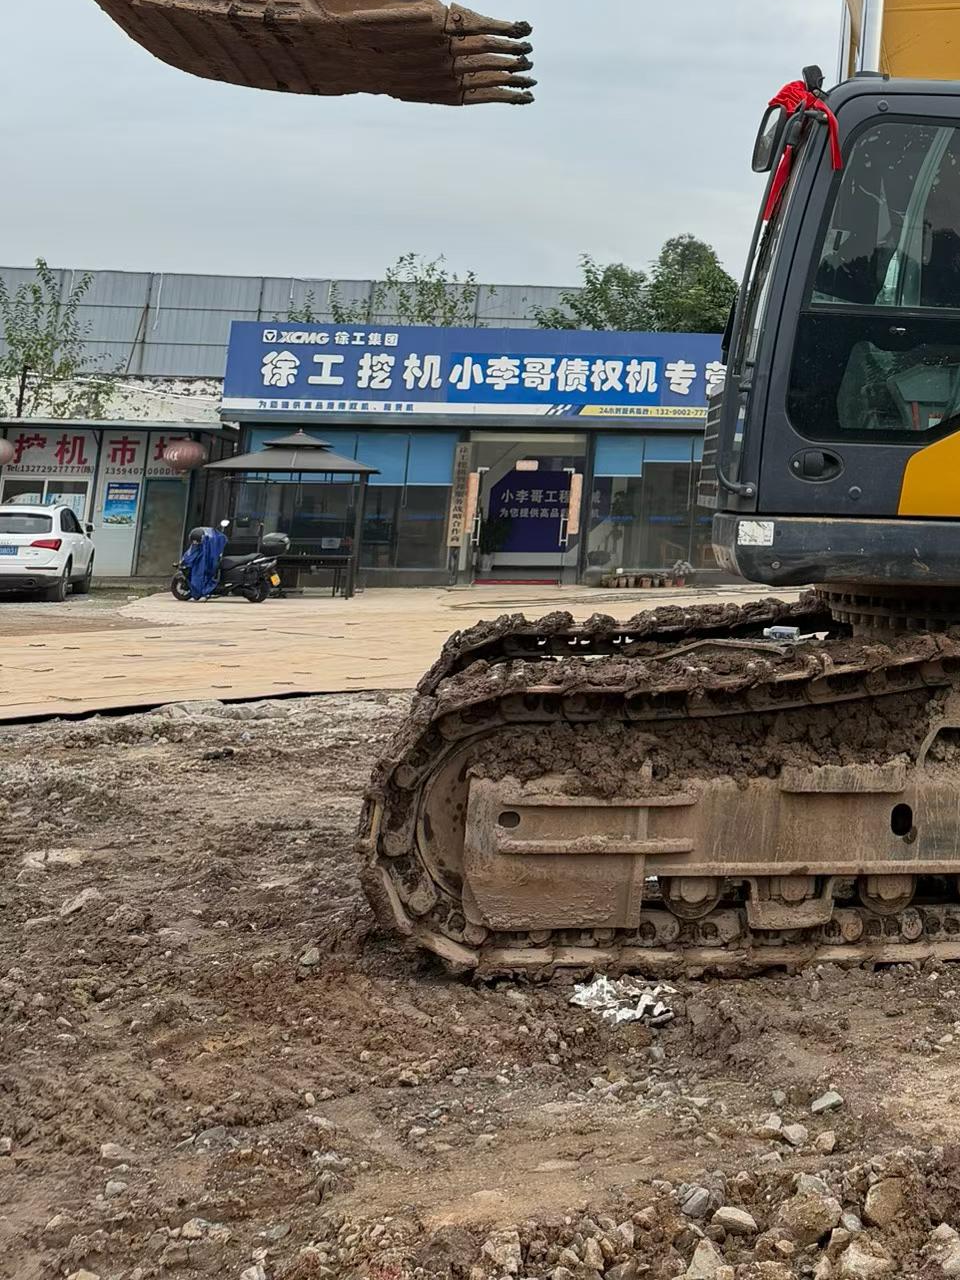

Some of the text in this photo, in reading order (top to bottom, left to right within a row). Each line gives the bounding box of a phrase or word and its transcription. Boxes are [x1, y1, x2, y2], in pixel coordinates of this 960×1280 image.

[277, 331, 399, 347] XCMG 徐工集团
